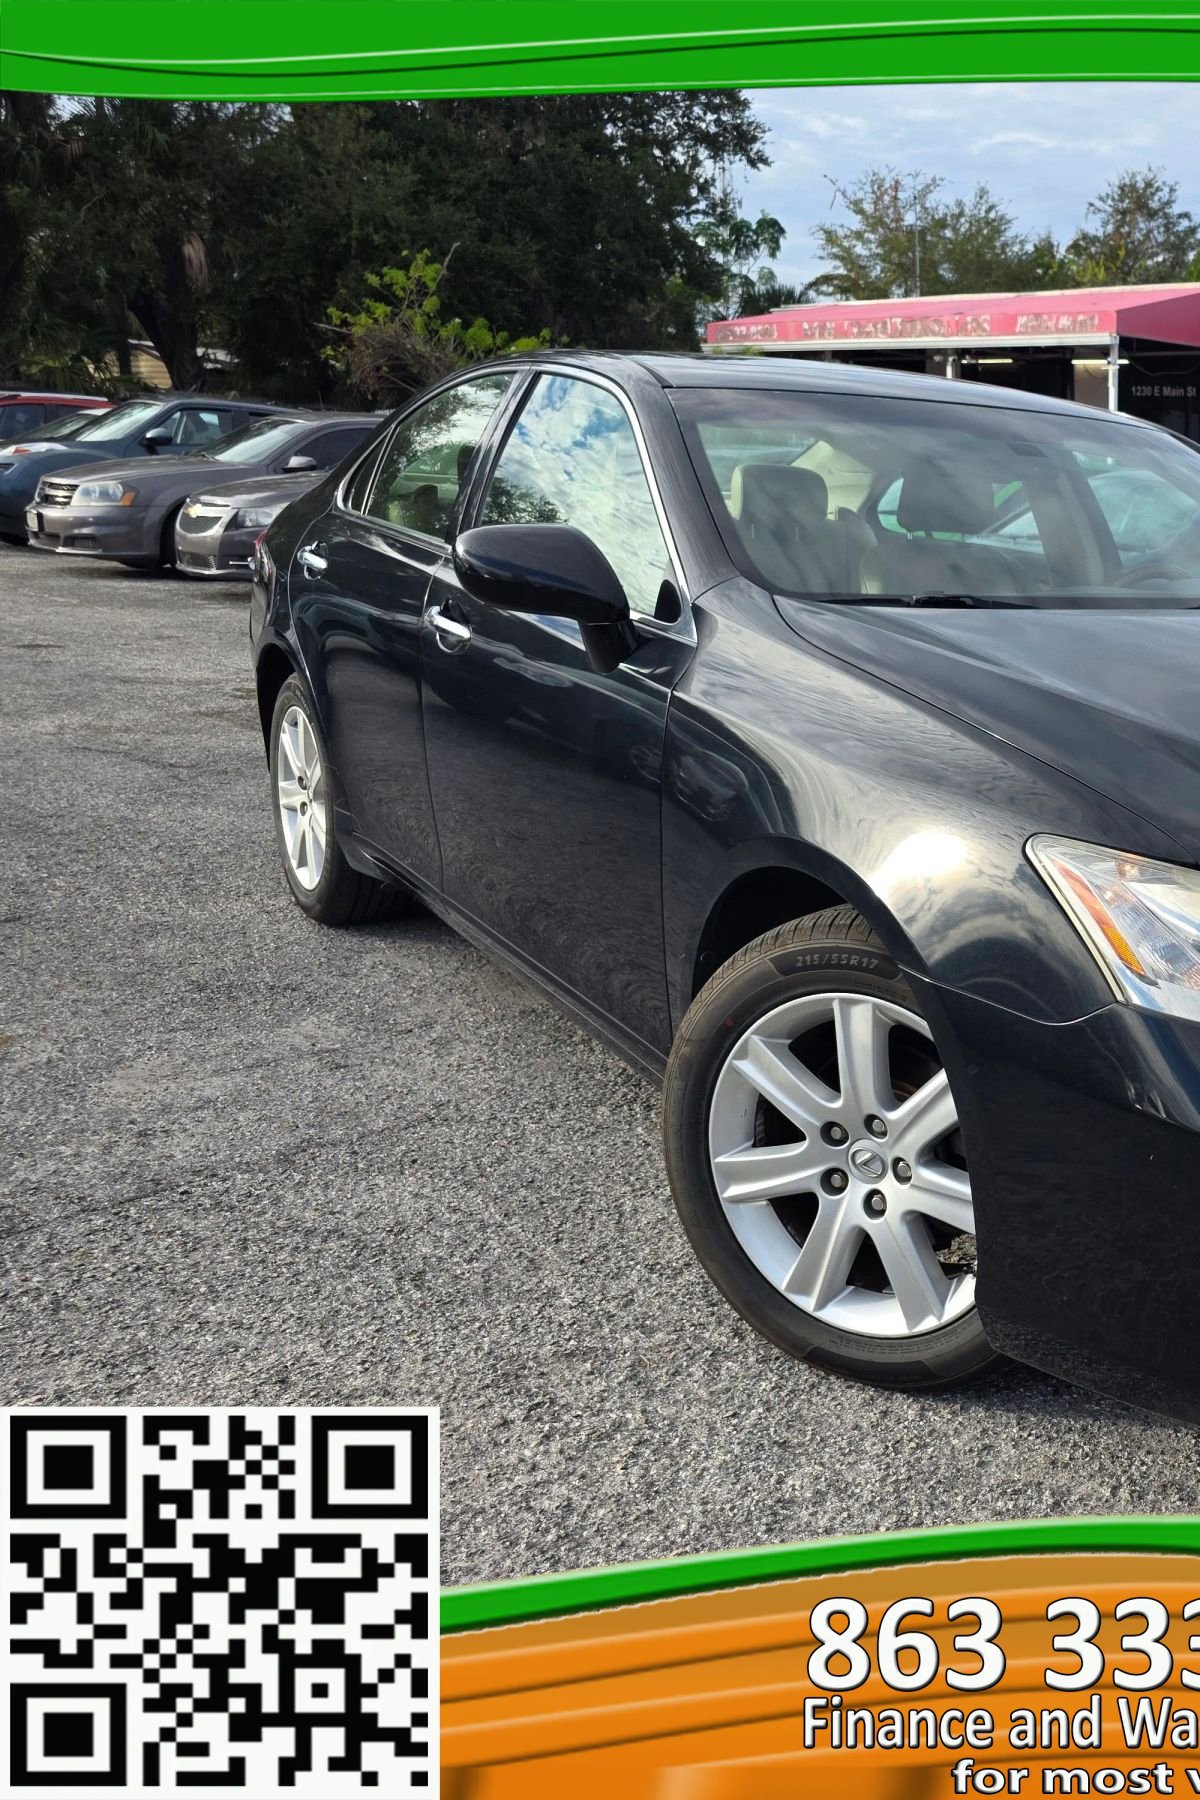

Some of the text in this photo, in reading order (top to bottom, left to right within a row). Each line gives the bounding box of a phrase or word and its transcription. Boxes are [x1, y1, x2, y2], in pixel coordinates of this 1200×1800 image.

[1131, 385, 1197, 397] 1230 E Main St
[796, 953, 879, 969] 215/55R17
